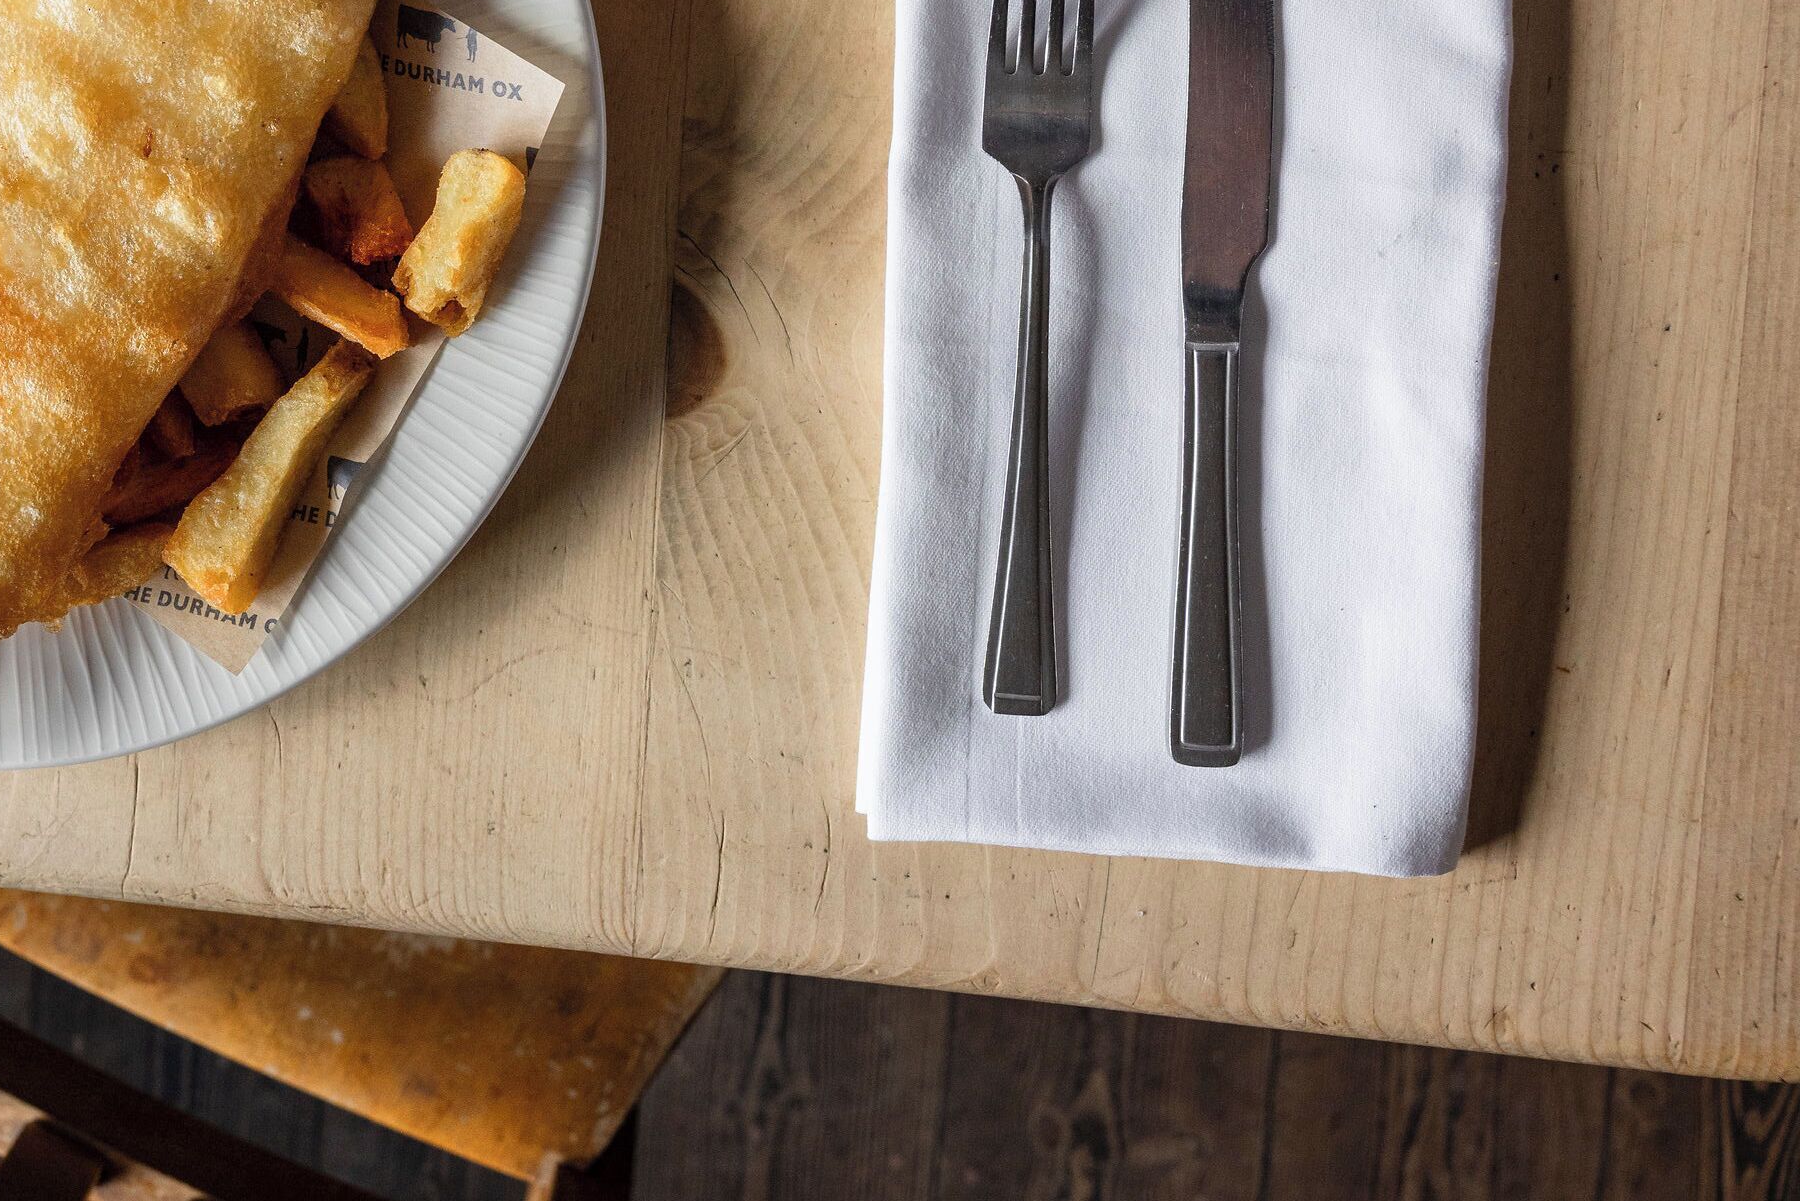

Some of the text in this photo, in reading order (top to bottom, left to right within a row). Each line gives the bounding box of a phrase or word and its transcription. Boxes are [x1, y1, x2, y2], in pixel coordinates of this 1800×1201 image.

[395, 59, 484, 93] DURHAM
[492, 81, 523, 101] OX
[157, 590, 258, 630] DURHAM
